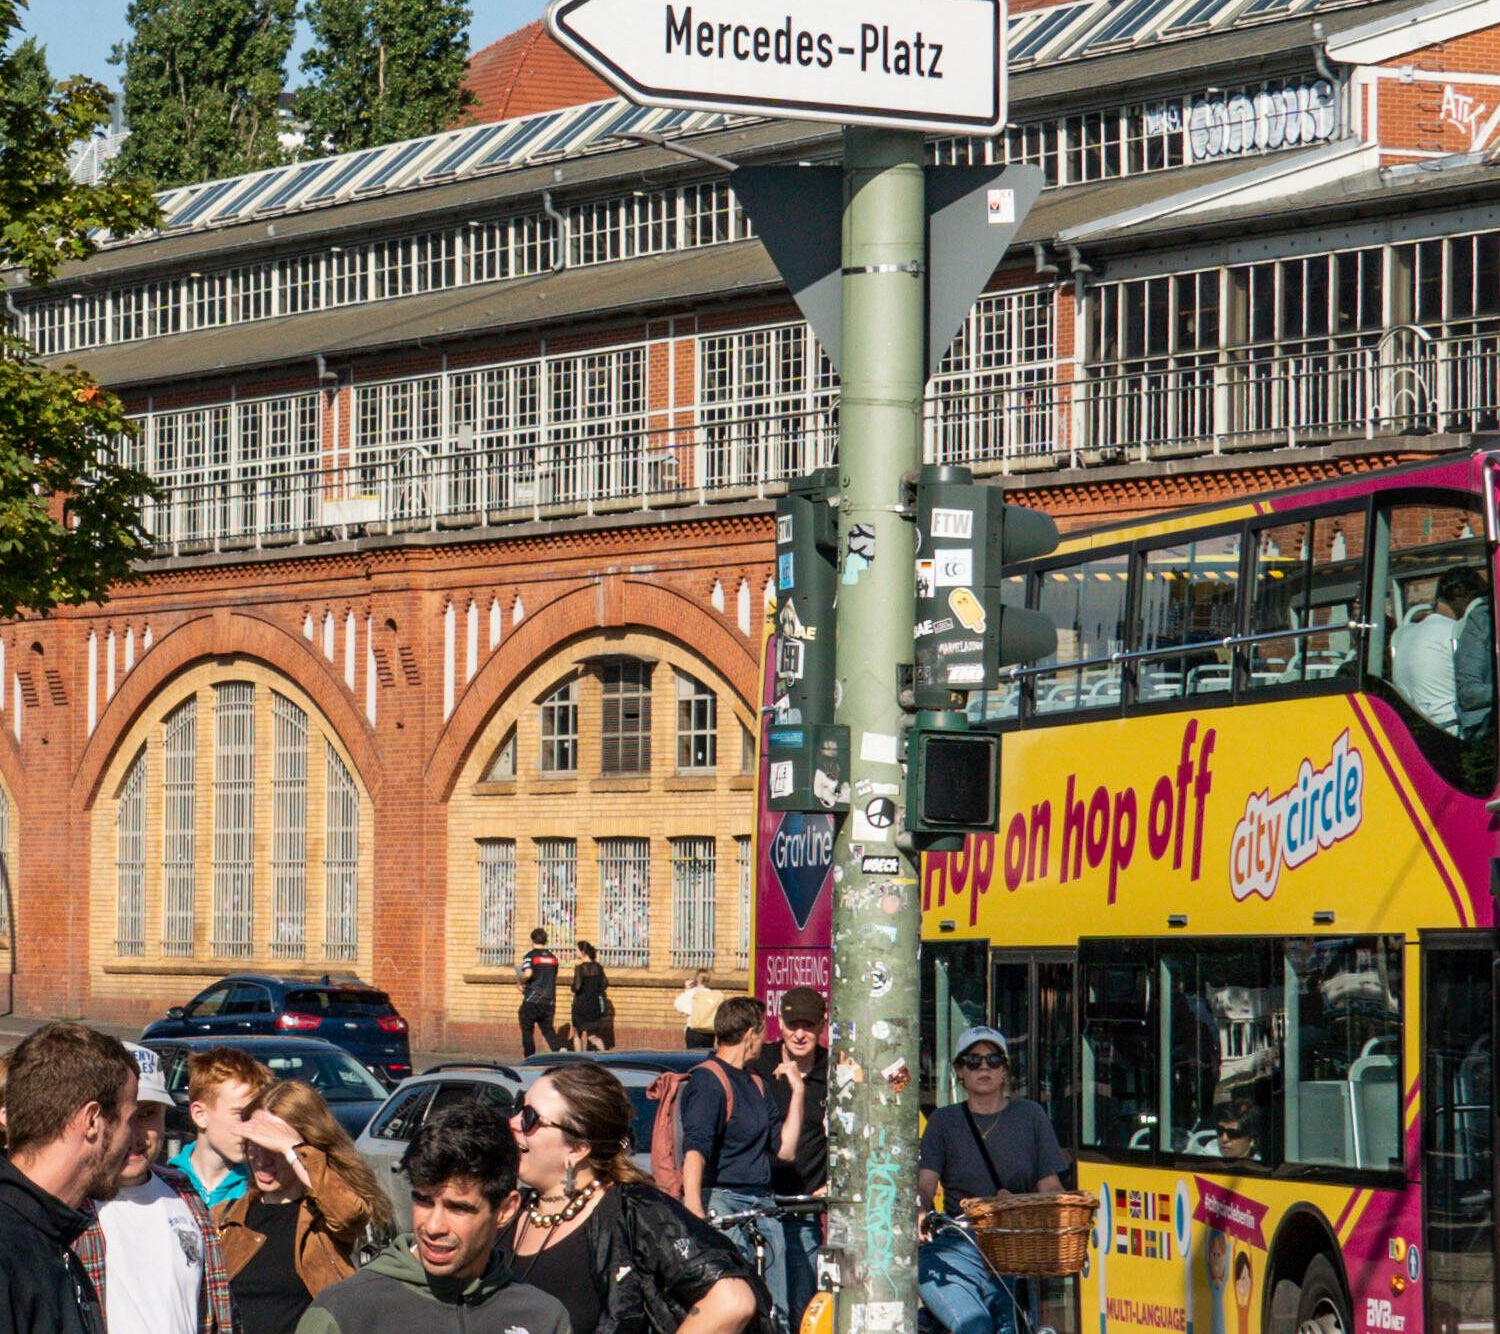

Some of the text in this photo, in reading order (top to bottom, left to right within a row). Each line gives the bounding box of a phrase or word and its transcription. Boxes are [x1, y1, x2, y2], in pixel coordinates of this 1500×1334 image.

[665, 4, 944, 79] Mercedes-Platz
[933, 512, 971, 535] FTW
[1003, 799, 1052, 892] on
[1059, 773, 1138, 905] hop
[1147, 718, 1217, 882] off
[766, 954, 829, 986] SIGHTSEEING
[1106, 1296, 1186, 1332] MULTI-LANGUAGE
